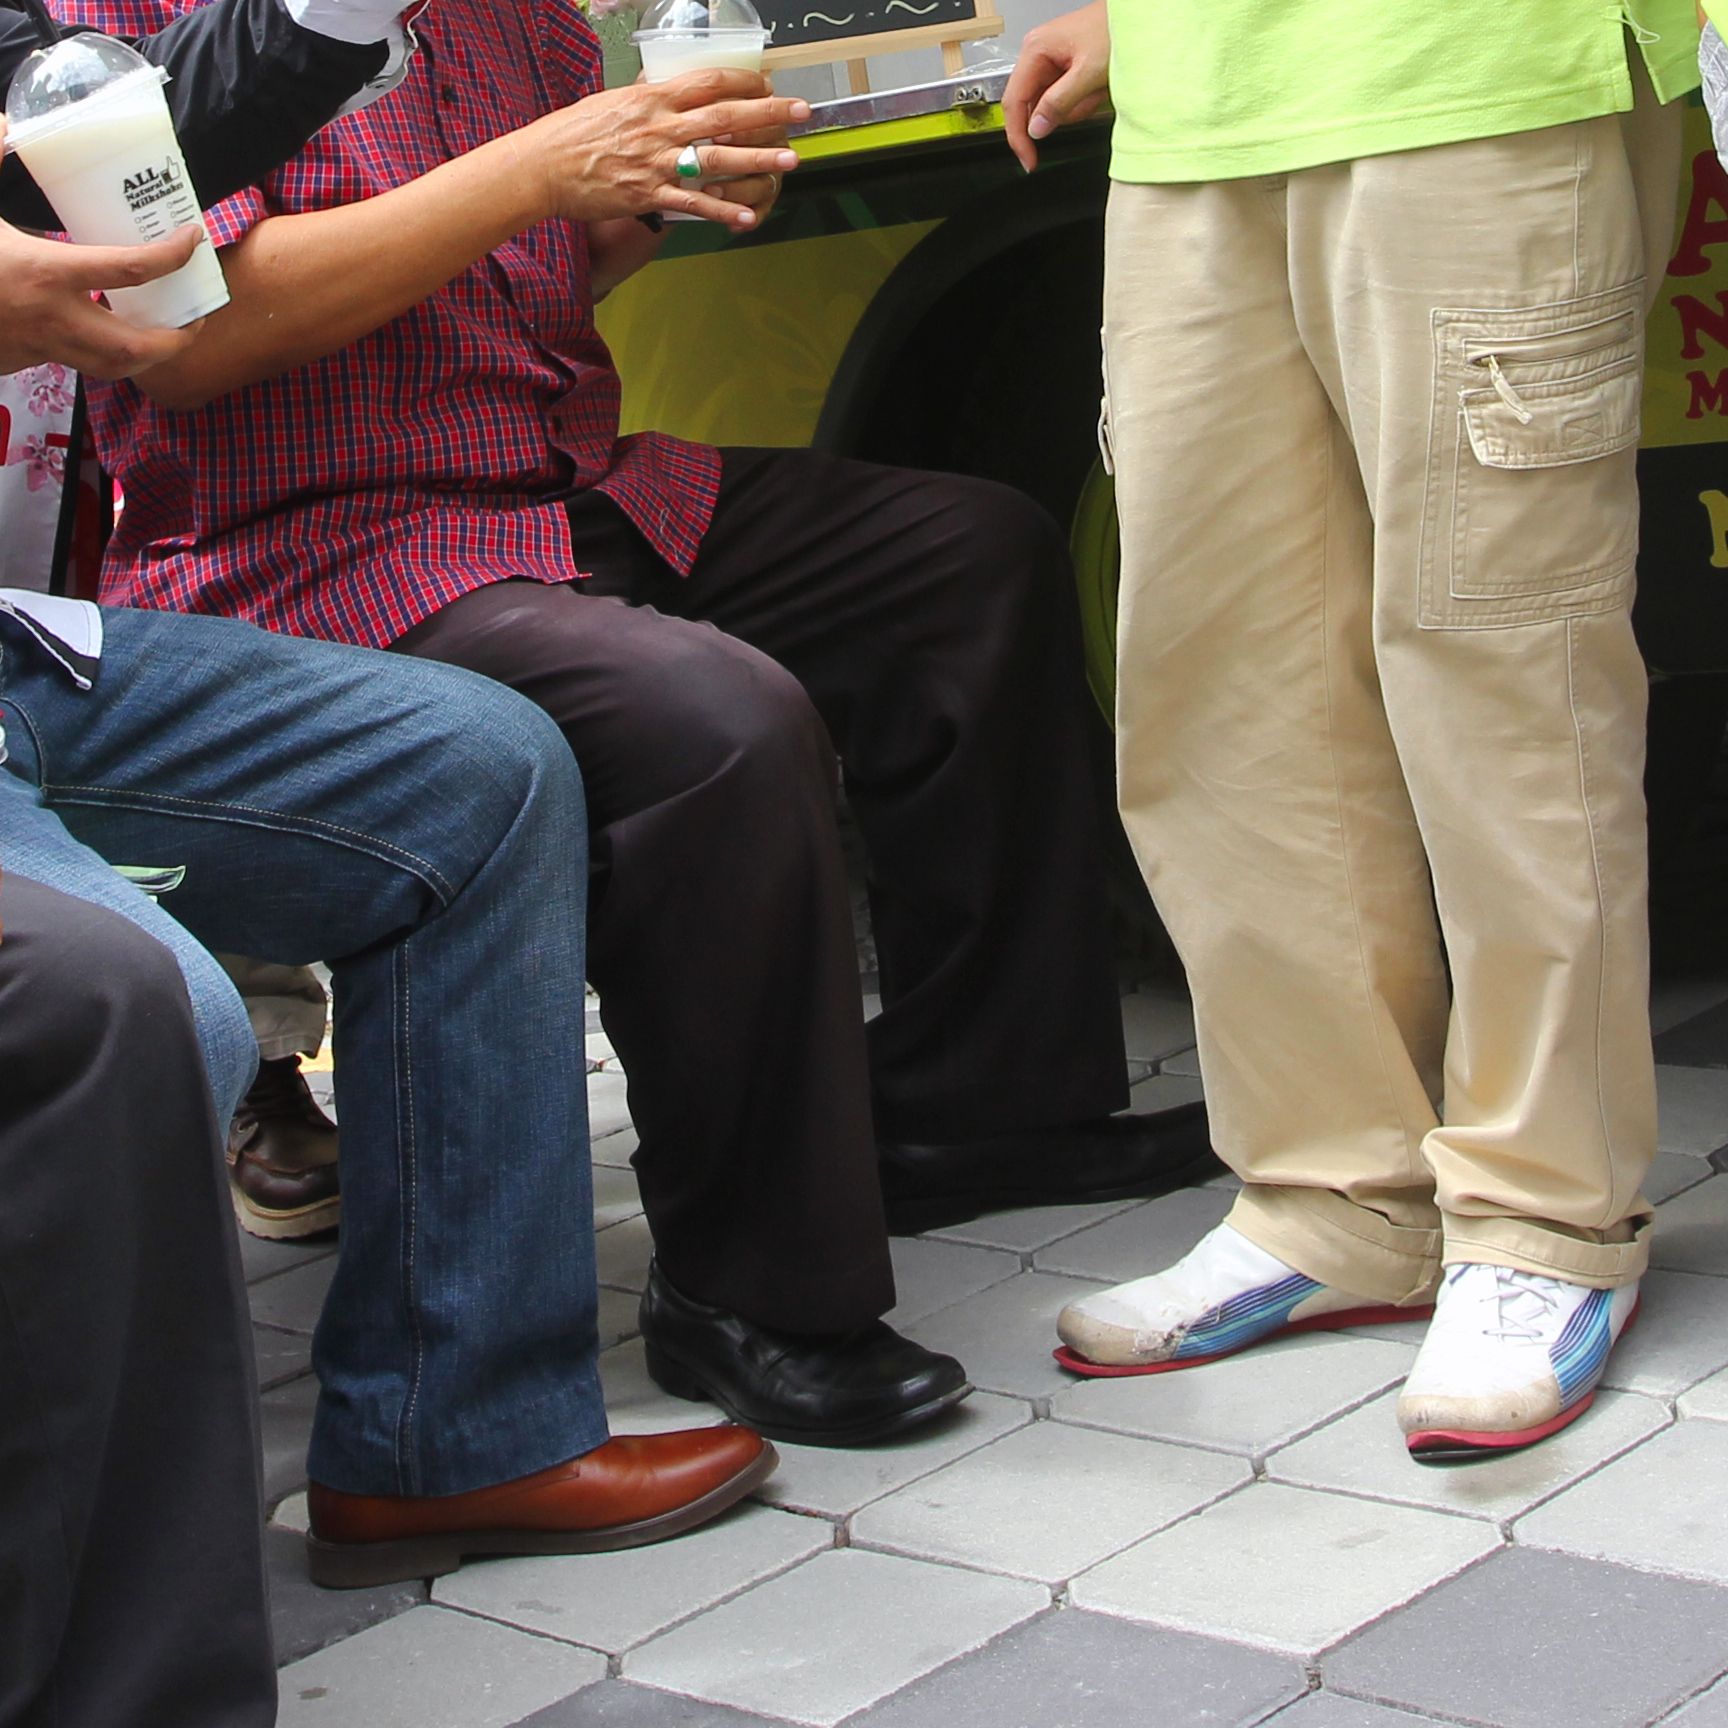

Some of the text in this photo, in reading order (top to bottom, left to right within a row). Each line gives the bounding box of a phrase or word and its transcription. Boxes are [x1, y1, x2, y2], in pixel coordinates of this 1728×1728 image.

[123, 167, 160, 194] ALL
[125, 180, 164, 202] Natural
[130, 182, 184, 213] Milkshakes
